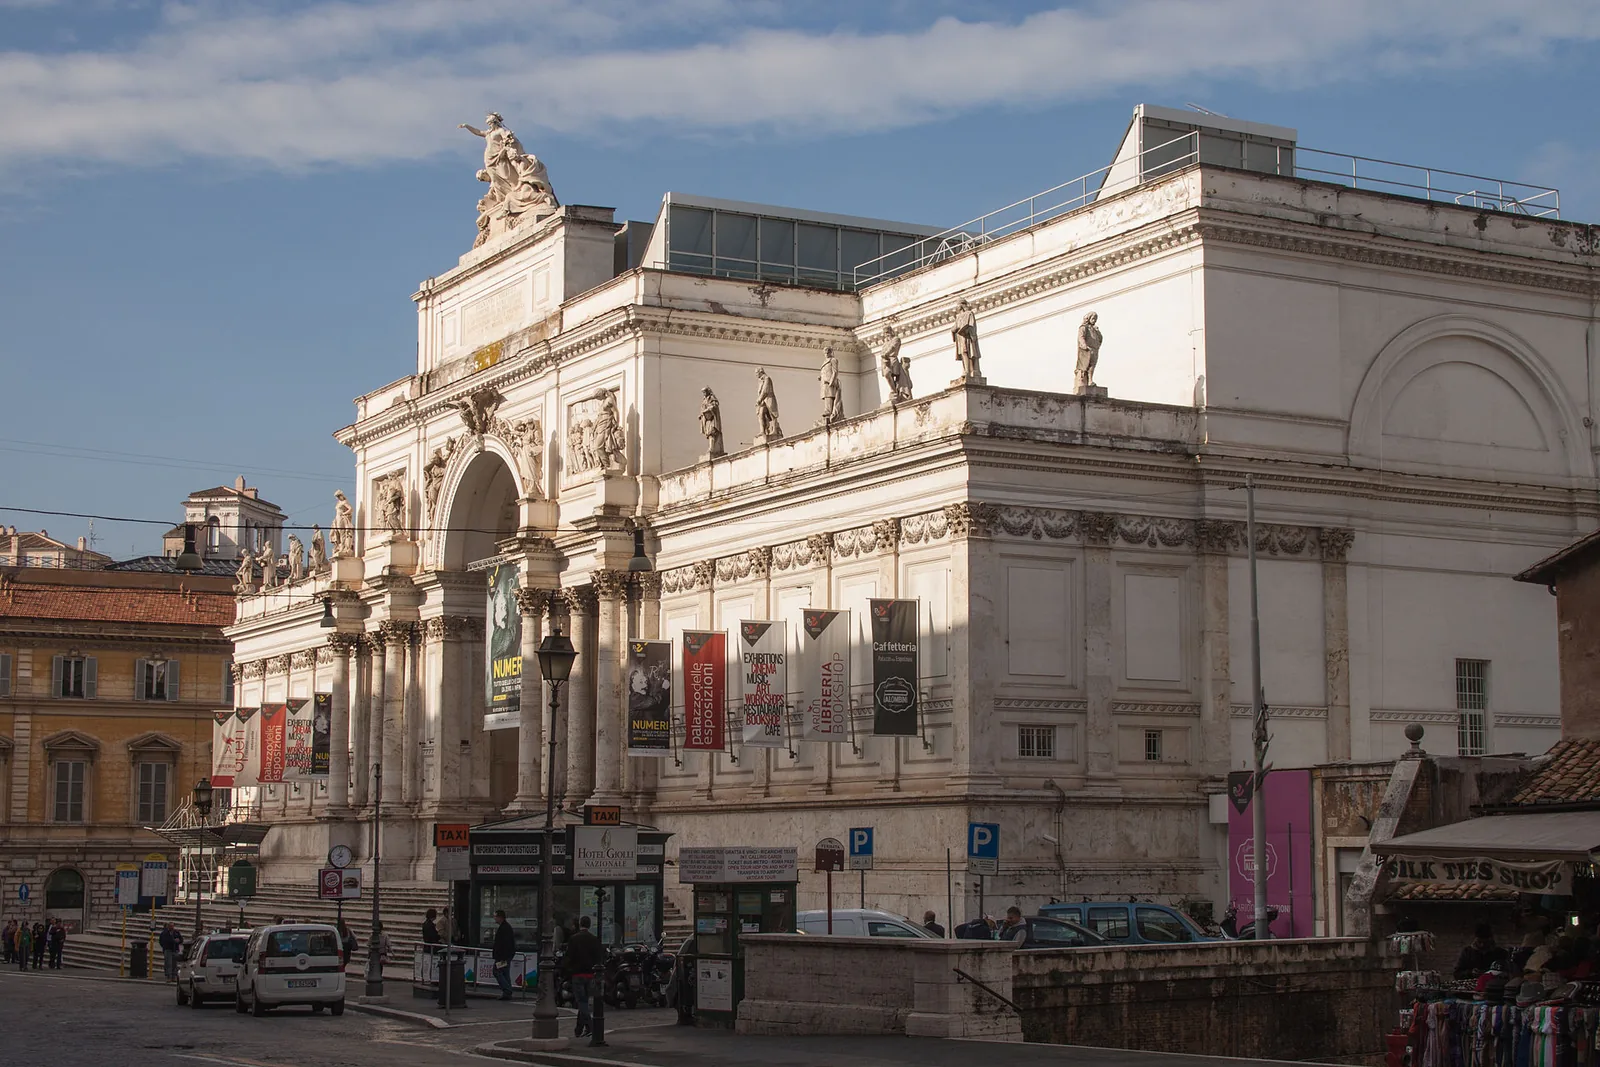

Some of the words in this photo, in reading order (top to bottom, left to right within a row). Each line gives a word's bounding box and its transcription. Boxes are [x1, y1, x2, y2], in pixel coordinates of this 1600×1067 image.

[873, 641, 918, 653] Caffetteria
[743, 652, 784, 665] EXHIBITIONS
[493, 656, 522, 678] NUMER
[751, 663, 777, 675] CINEMA
[746, 673, 769, 684] MUSIC
[756, 683, 771, 694] ART
[832, 652, 844, 734] BOOKSHOP
[692, 662, 704, 746] palazzodelle
[702, 662, 715, 746] esposizioni
[744, 693, 785, 705] WORKSHOPS
[821, 662, 832, 734] LIBRERIA
[743, 703, 784, 716] RESTAURANT
[287, 718, 313, 727] EXHIBITION
[632, 719, 669, 730] NUMERI
[745, 714, 781, 726] BOOKSHOP
[272, 725, 283, 781] esposizioni
[593, 811, 618, 821] TAXI
[440, 830, 467, 841] TAXI
[854, 830, 868, 853] P
[973, 826, 993, 854] P
[507, 846, 538, 854] TOURISTIQUES
[578, 847, 605, 859] HOTEL
[606, 847, 634, 859] GIOLLI
[1388, 860, 1437, 879] SILK
[1441, 861, 1493, 881] TIES
[1500, 866, 1562, 890] SHOP
